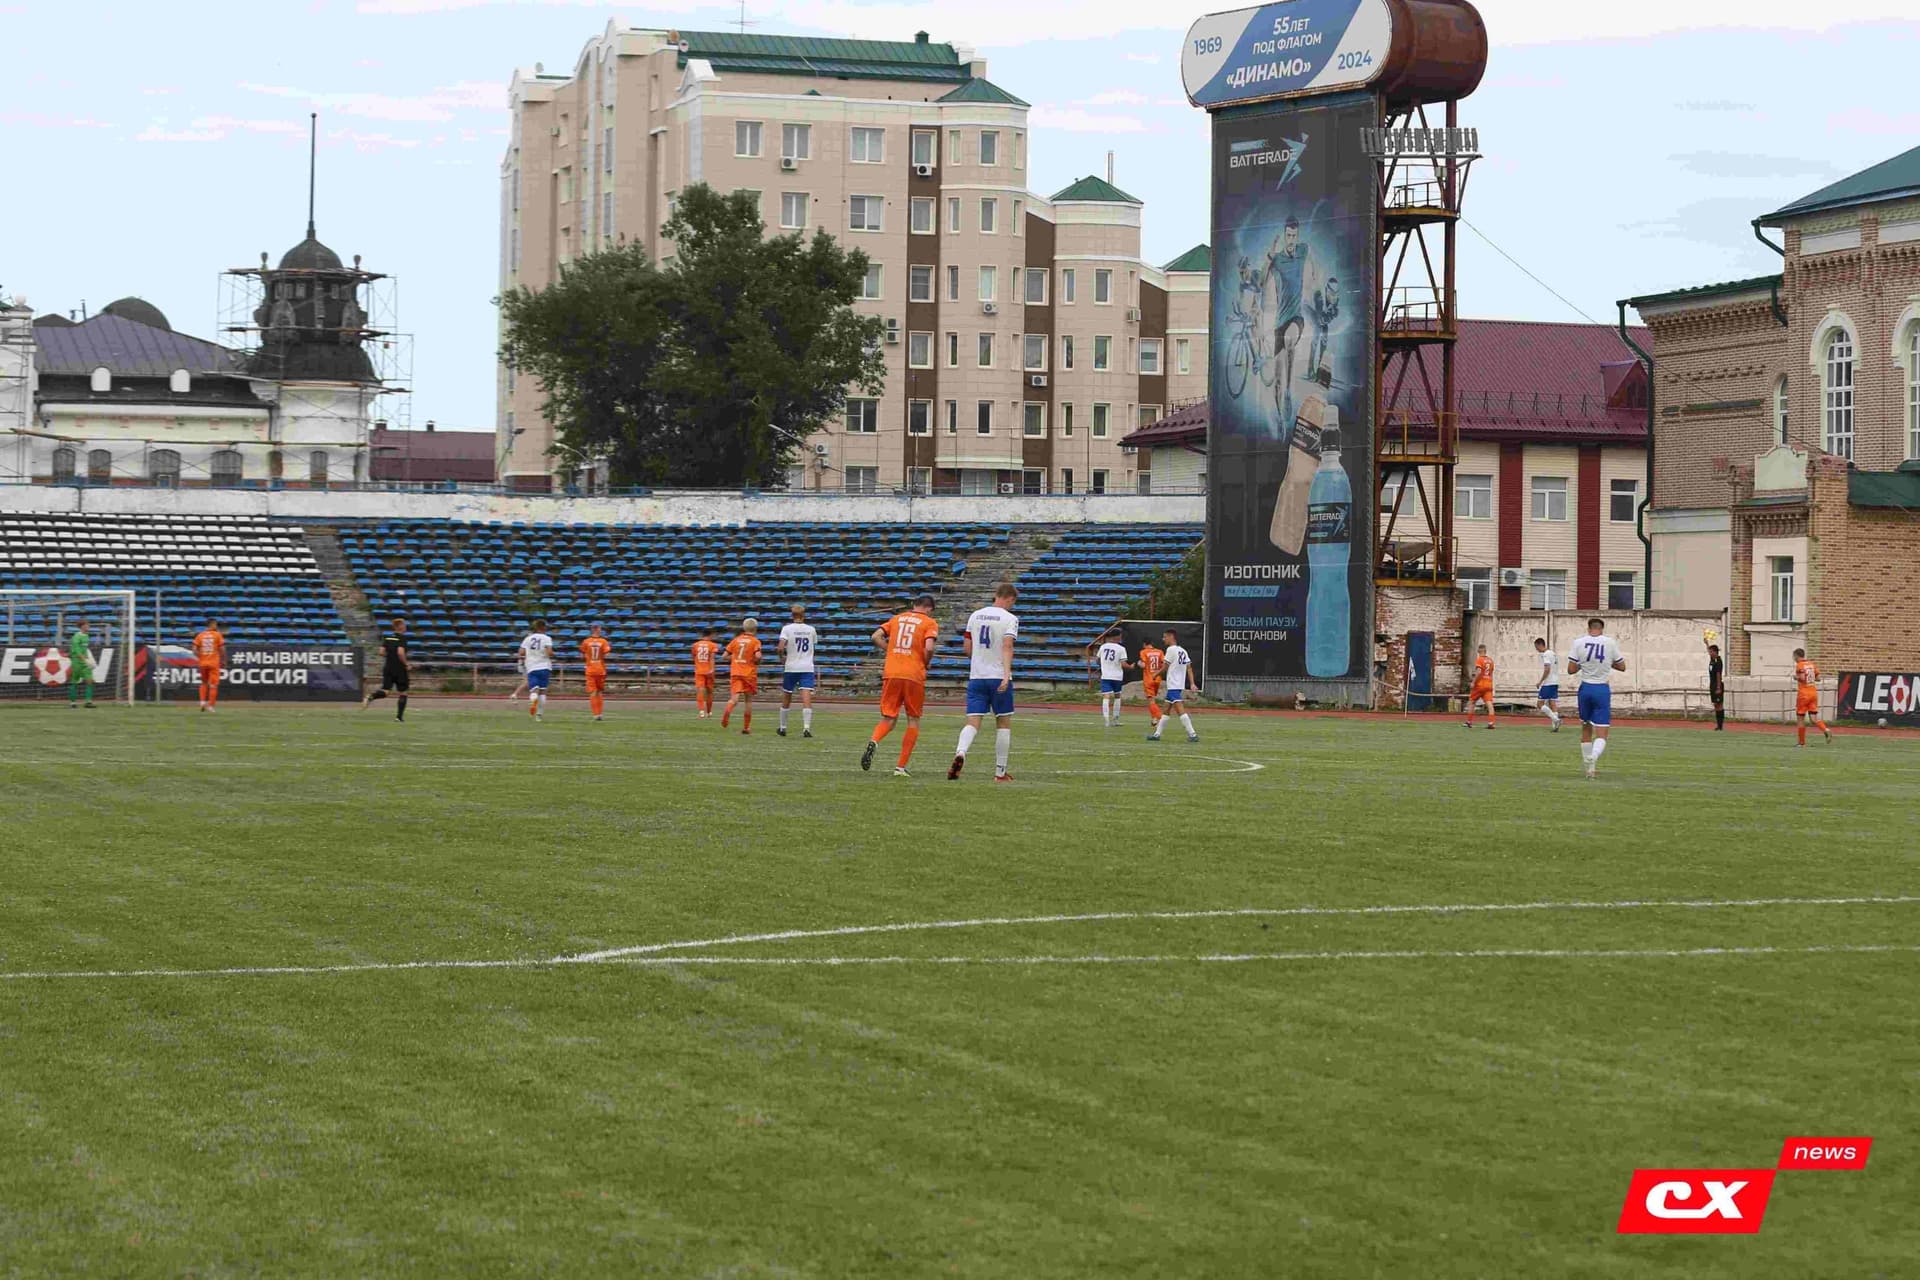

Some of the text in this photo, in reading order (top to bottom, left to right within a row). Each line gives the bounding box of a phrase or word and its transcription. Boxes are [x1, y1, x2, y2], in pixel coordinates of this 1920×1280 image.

[1273, 16, 1309, 35] 55 ЛЕТ
[1194, 37, 1222, 56] 1969
[1252, 31, 1322, 55] ПОД ФЛАГОМ
[1338, 50, 1373, 70] 2024
[1226, 58, 1312, 89] «ДИНАМО»
[1230, 148, 1297, 168] BATTERADE
[1224, 565, 1301, 579] ИЗОТОНИК
[1223, 617, 1298, 627] ВОЗЬМИ ПАУЗУ.
[530, 638, 542, 650] 21
[896, 623, 916, 648] 15
[979, 625, 991, 648] 4
[1223, 630, 1287, 641] ВОССТАНОВИ
[697, 647, 709, 660] 22
[738, 643, 746, 660] 7
[795, 637, 809, 653] 78
[1223, 643, 1253, 654] СИЛЫ.
[1585, 642, 1606, 663] 74
[231, 652, 354, 665] #МЫВМЕСТЕ
[1103, 648, 1116, 661] 73
